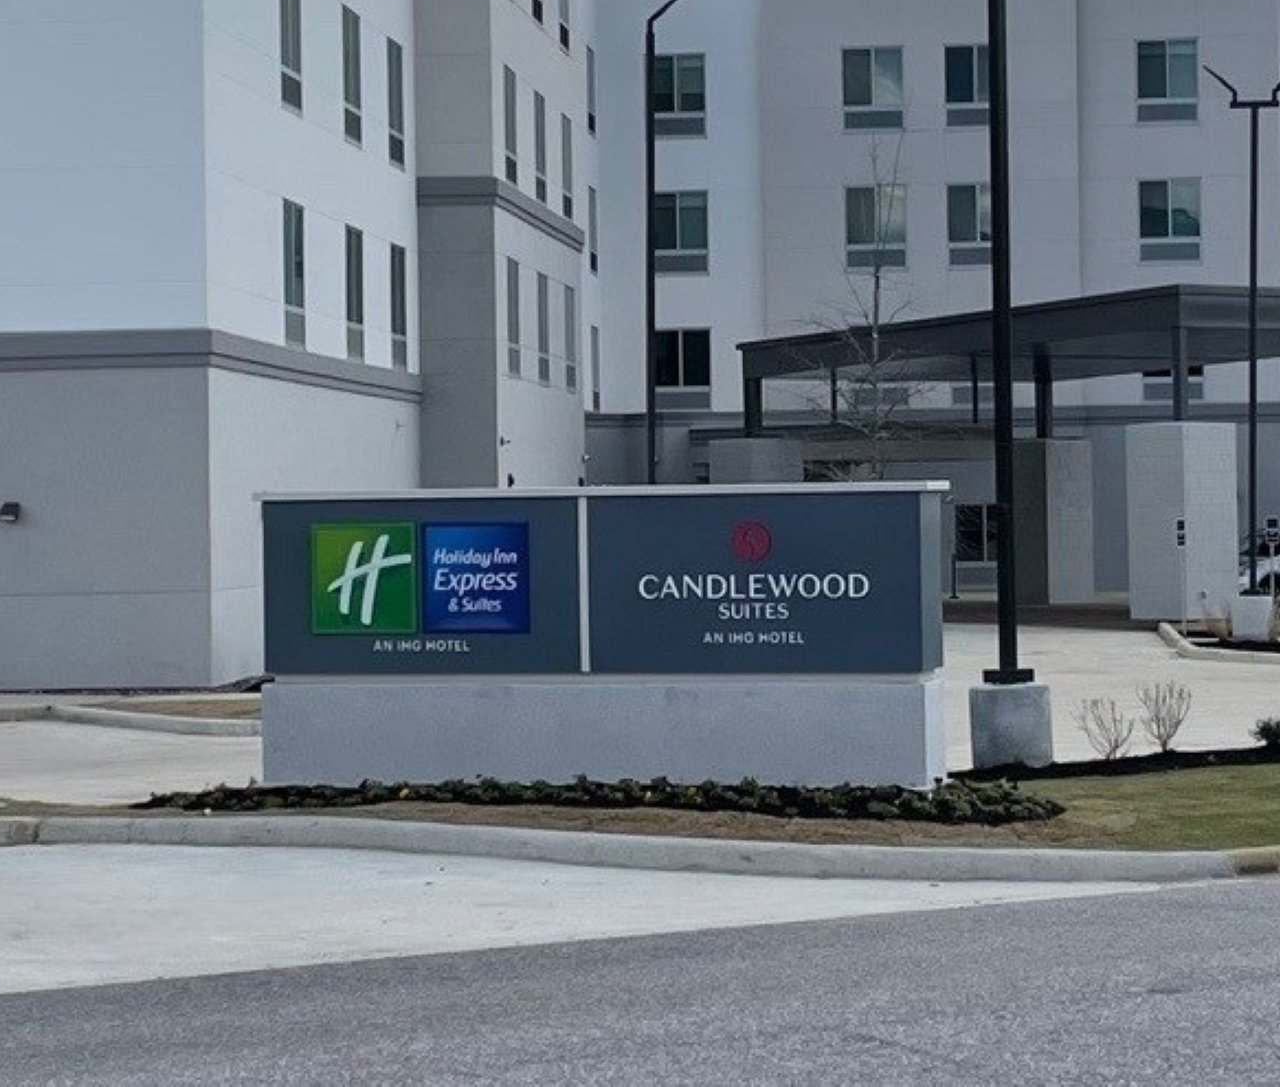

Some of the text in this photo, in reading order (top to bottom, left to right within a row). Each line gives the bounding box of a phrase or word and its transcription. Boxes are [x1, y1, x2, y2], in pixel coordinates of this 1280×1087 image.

[433, 547, 518, 568] Holiday Inn
[433, 568, 518, 597] Express
[638, 573, 870, 600] CANDLEWOOD
[448, 597, 502, 613] & Suites
[718, 602, 789, 620] SUITES
[373, 639, 470, 652] AN IHG HOTEL
[703, 631, 805, 644] AN IHG HOTEL
